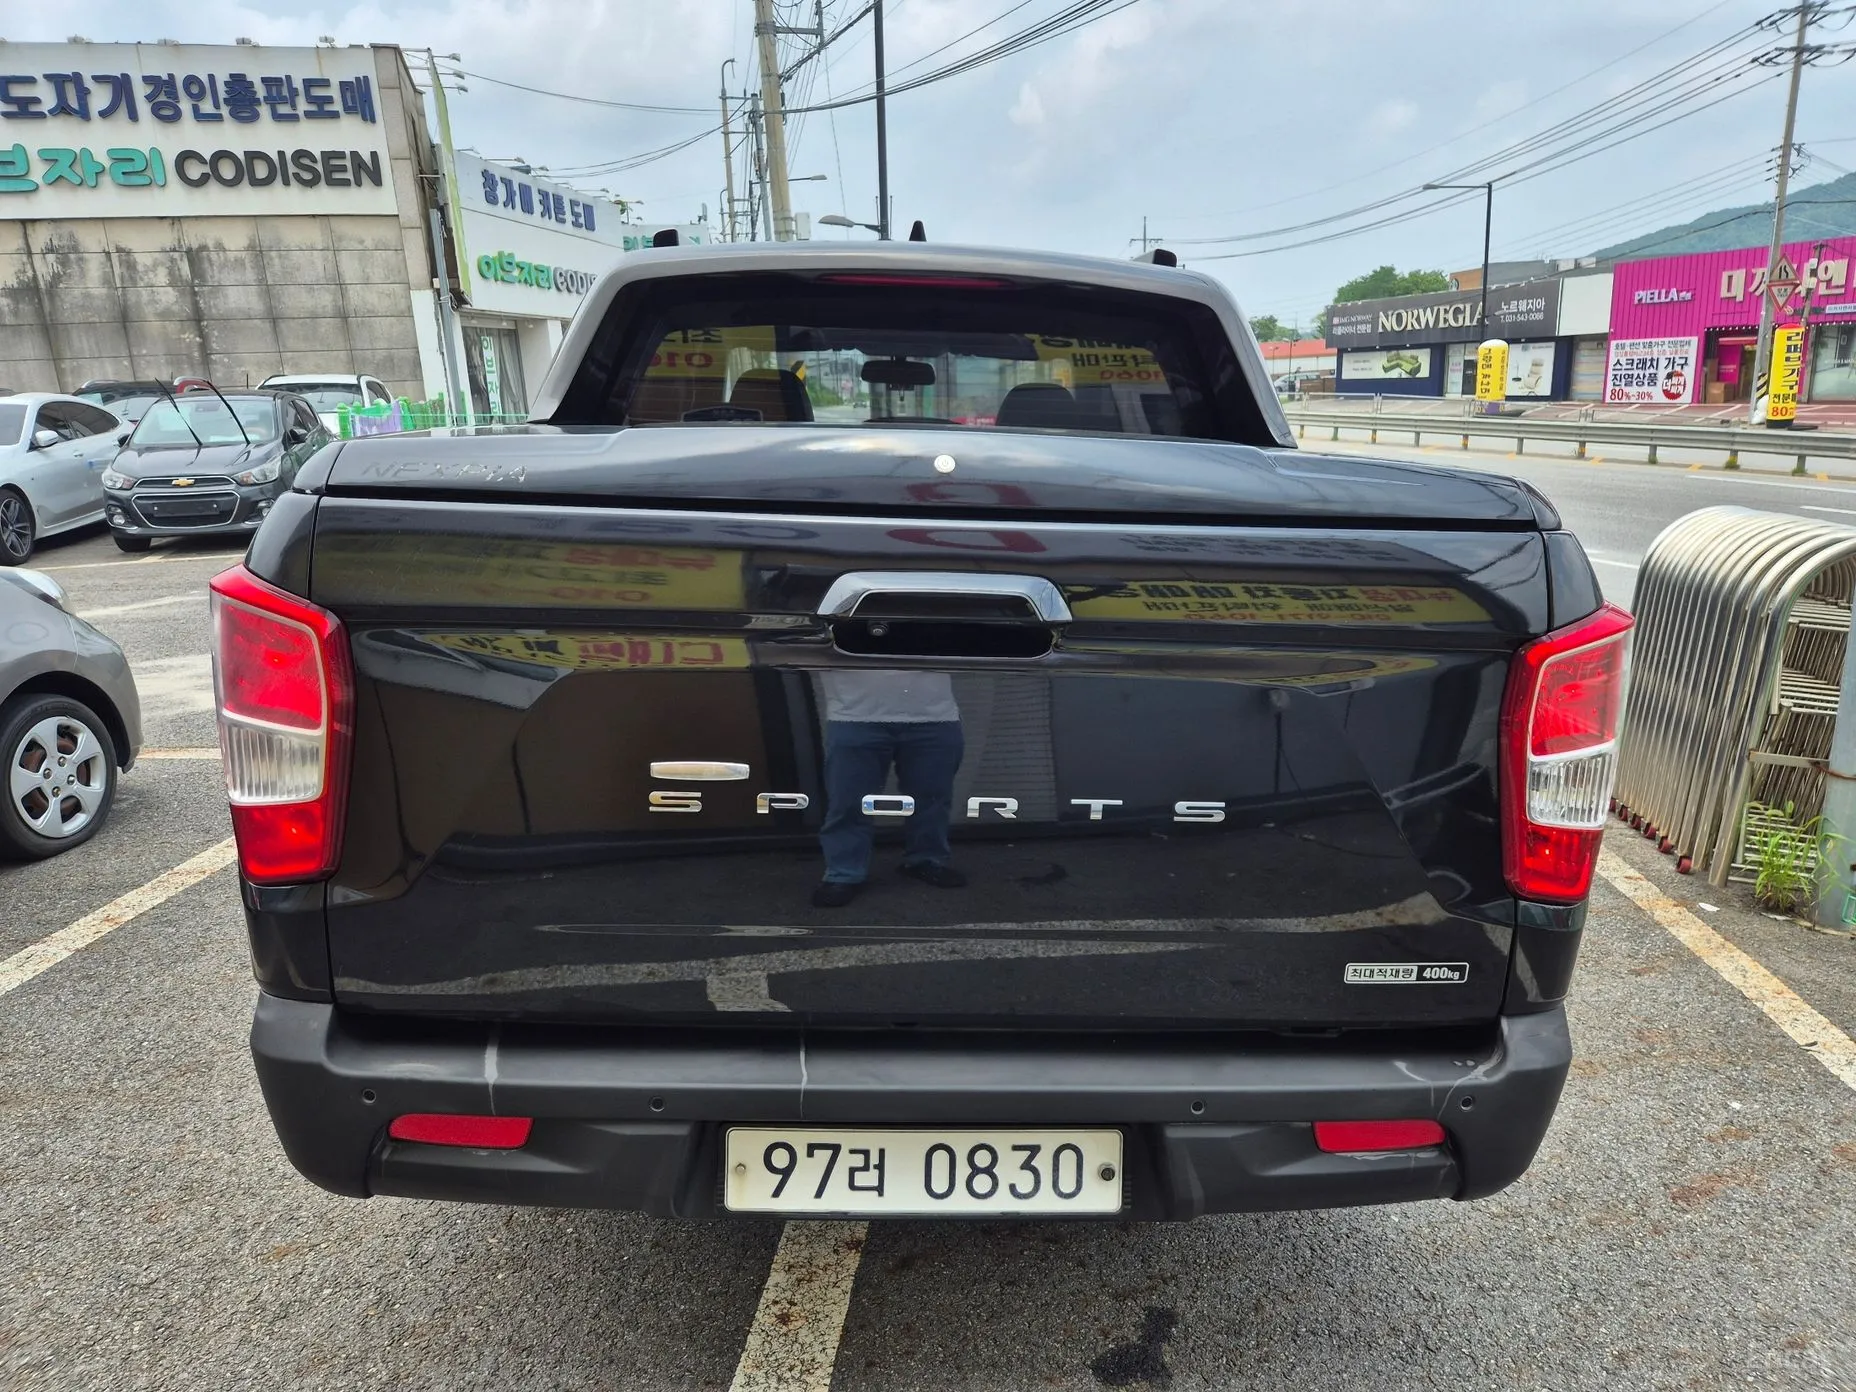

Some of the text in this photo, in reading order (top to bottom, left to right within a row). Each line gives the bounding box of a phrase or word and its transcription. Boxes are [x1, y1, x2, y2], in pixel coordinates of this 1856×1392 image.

[174, 149, 382, 188] CODISEN
[478, 250, 552, 289] 이브자리
[1634, 287, 1679, 304] PIELLA
[481, 336, 502, 414] 이브자리
[1611, 372, 1659, 387] 진열상품
[1612, 356, 1689, 371] 스크래치 가구
[648, 790, 1227, 822] SPORTS
[1350, 967, 1460, 980] 최대적재량 400kg
[762, 1141, 1084, 1201] 97러 0830
